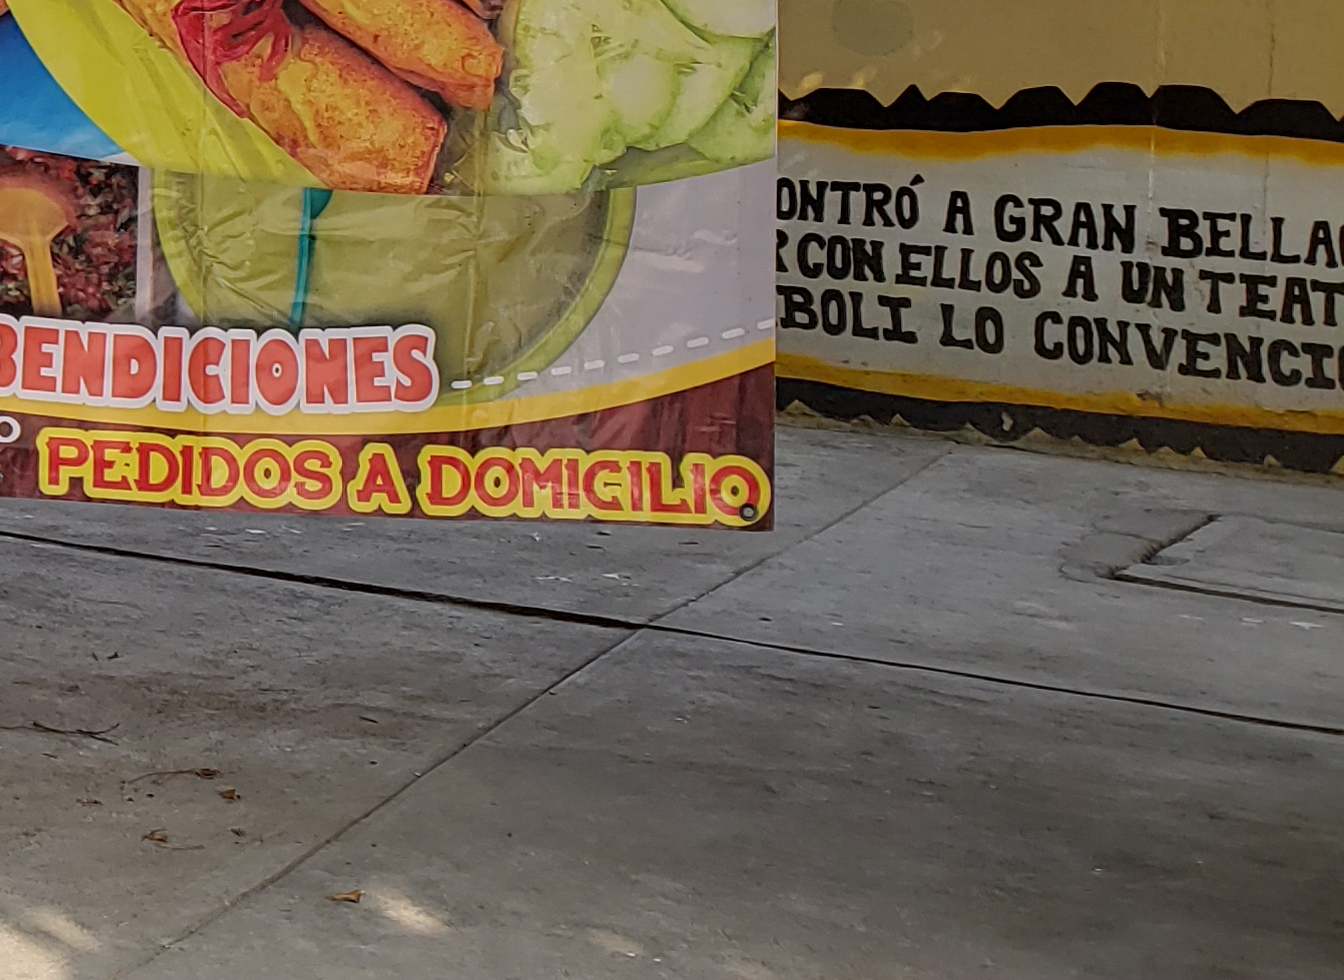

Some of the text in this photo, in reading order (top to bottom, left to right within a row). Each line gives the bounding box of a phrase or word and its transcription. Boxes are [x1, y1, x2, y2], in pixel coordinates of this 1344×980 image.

[944, 191, 973, 236] A
[994, 194, 1138, 255] GRAN
[1160, 207, 1344, 269] BELLA
[797, 233, 886, 282] CON
[895, 242, 1043, 299] ELLOS
[1062, 256, 1097, 301] A
[1122, 260, 1185, 312] UN
[1199, 268, 1344, 327] TEAT
[776, 284, 1344, 391] BOLI LO CONVENCI
[44, 433, 763, 521] PEDIDOS A DOMICILIO
